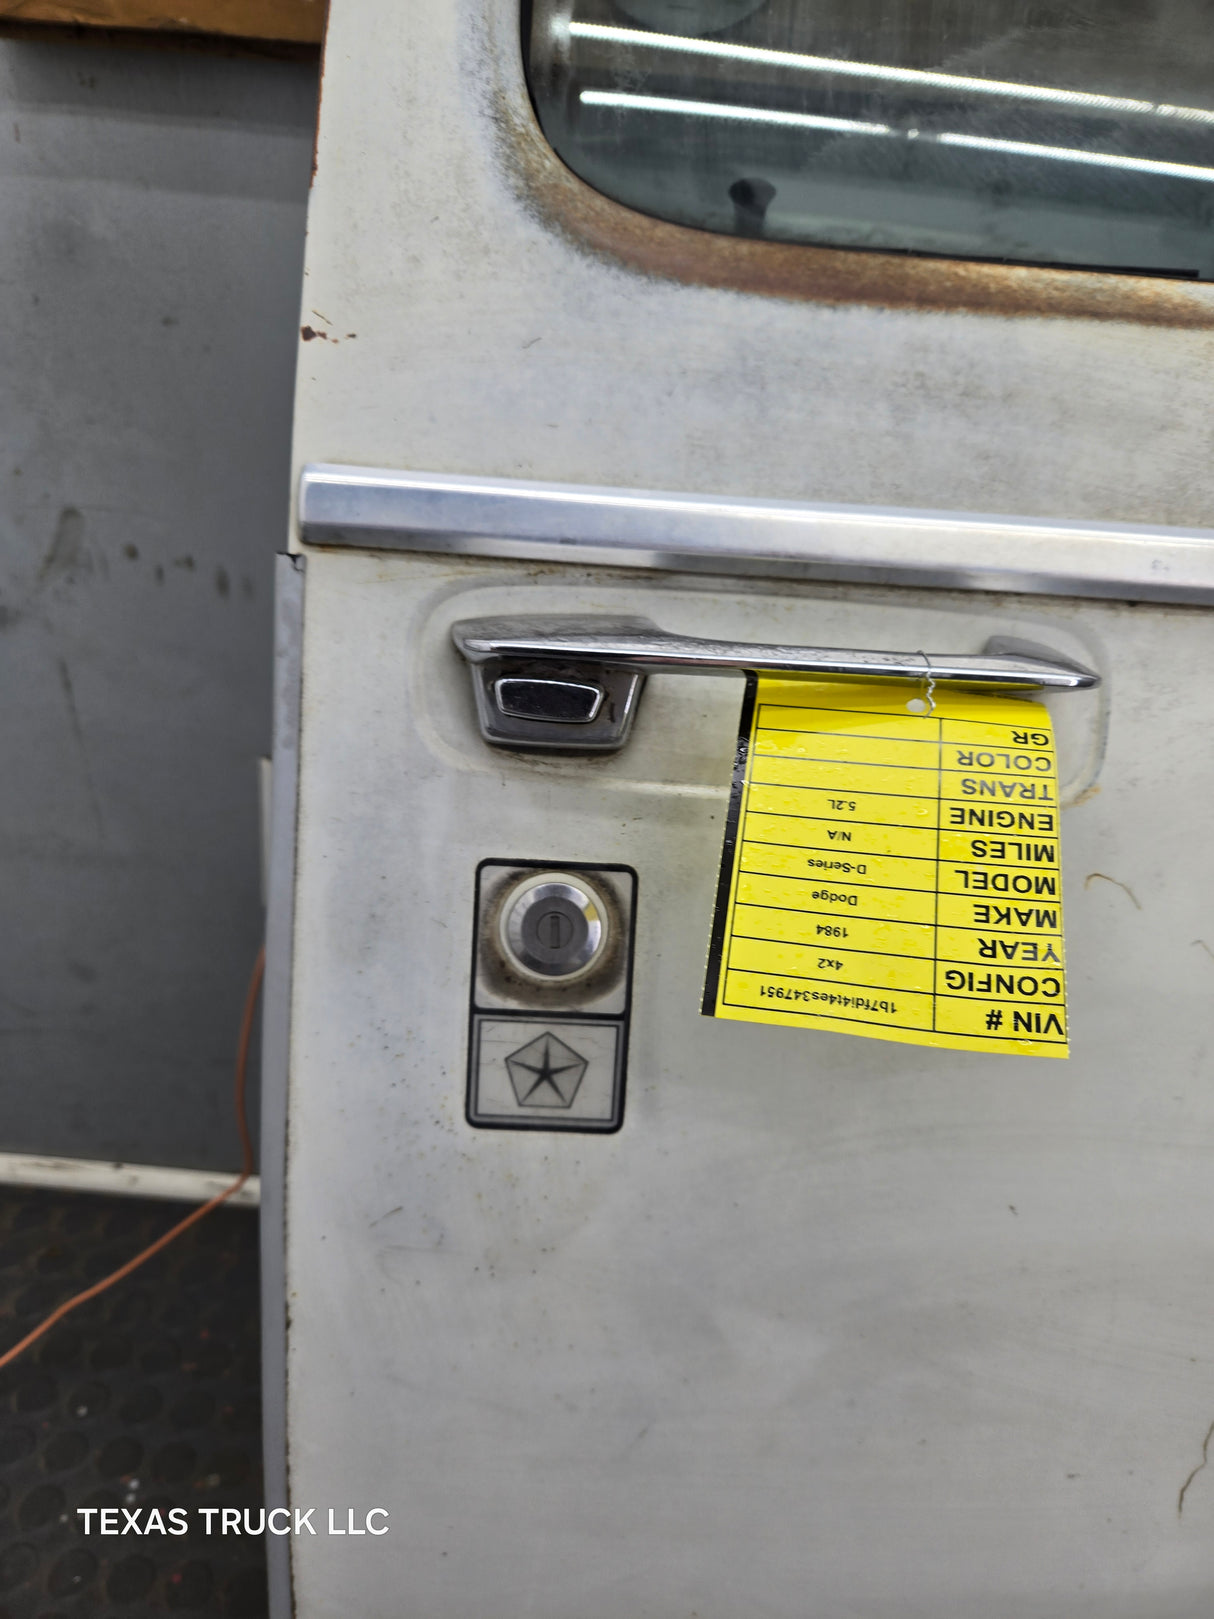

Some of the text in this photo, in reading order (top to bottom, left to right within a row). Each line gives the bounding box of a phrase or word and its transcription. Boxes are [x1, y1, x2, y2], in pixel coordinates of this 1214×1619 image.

[1012, 731, 1049, 745] GR
[957, 751, 1052, 771] COLOR
[962, 779, 1053, 800] TRANS
[828, 799, 856, 811] 5.2L
[950, 808, 1053, 831] ENGINE
[827, 830, 851, 842] N/A
[971, 840, 1055, 862] MILES
[808, 858, 867, 875] D-Series
[955, 870, 1056, 895] MODEL
[812, 891, 858, 906] Dodge
[974, 904, 1057, 928] MAKE
[816, 924, 848, 938] 1984
[978, 938, 1060, 962] YEAR
[818, 958, 843, 970] 4x2
[946, 970, 1061, 996] CONFIG
[986, 1010, 1064, 1035] VIN #
